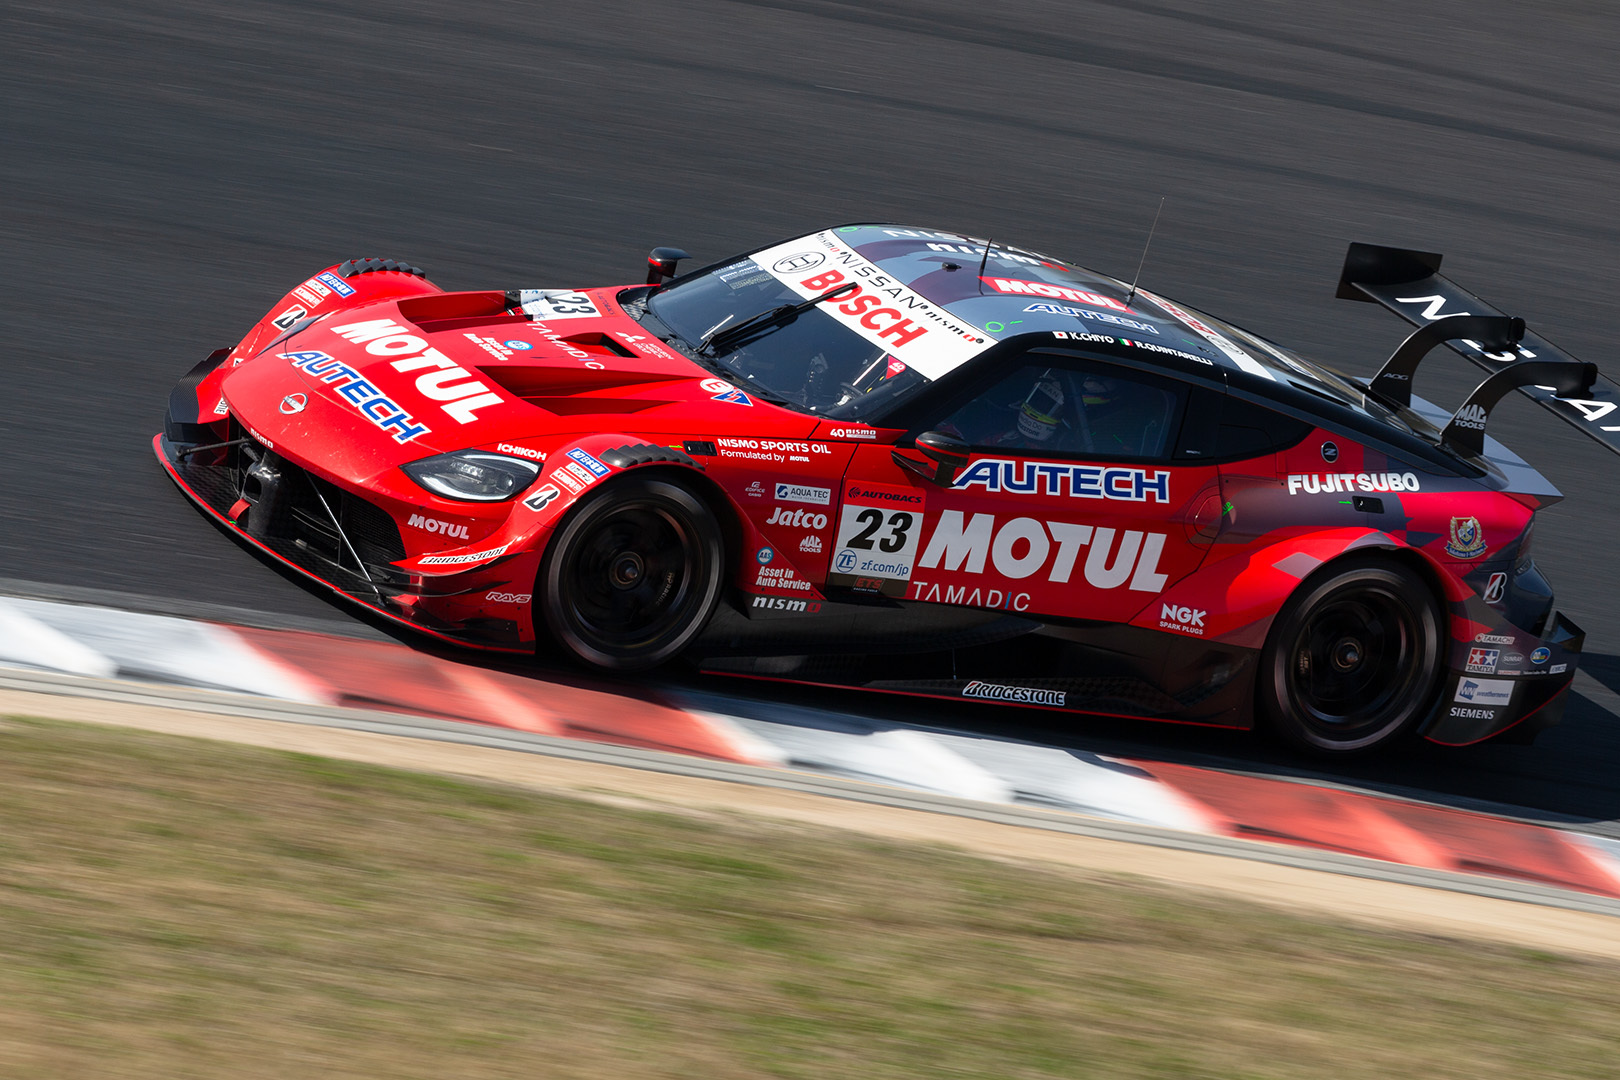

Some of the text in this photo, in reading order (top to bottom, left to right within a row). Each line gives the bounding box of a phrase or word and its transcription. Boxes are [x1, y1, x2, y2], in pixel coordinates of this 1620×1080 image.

[926, 243, 1070, 272] nismo
[837, 253, 922, 310] NISSAN
[994, 279, 1127, 312] MOTUL
[925, 311, 977, 341] nismo
[1022, 303, 1160, 334] AUTECH
[1070, 332, 1115, 344] K.CHIYO
[1135, 340, 1213, 366] R.QUINTARELLI
[330, 319, 505, 424] MOTUL
[275, 350, 432, 445] AUTECH
[1456, 404, 1487, 423] MAC
[830, 429, 845, 437] 40
[1455, 420, 1485, 430] TOOLS
[250, 427, 274, 448] nismo
[717, 438, 831, 454] NISMO SPORTS OIL
[497, 443, 547, 460] ICHIKOH
[720, 450, 772, 461] Formulated
[774, 453, 785, 462] by
[952, 458, 1171, 504] AUTECH
[1287, 472, 1420, 495] FUJITSUBO
[790, 489, 829, 498] AQUA TEC
[861, 490, 922, 503] AUTOBACS
[407, 513, 470, 540] MOTUL
[766, 507, 827, 530] Jatco
[846, 508, 913, 553] 23
[799, 535, 822, 548] MAC
[420, 546, 507, 564] BRIDGESTONE
[759, 551, 773, 560] AAS
[917, 509, 1169, 593] MOTUL
[758, 566, 794, 579] Asset in
[838, 554, 909, 576] ZF zf.com/jp
[756, 575, 811, 591] Auto Service
[855, 577, 882, 588] ETS
[485, 591, 532, 603] RAYS
[752, 597, 822, 613] nismo
[912, 581, 1031, 611] TAMADIC
[1160, 602, 1208, 628] NGK
[1159, 621, 1204, 635] SPARK PLUGS
[1484, 635, 1514, 644] TAMACHI
[1467, 665, 1494, 673] TAMIYA
[962, 680, 1067, 706] BRIDGESTONE
[1450, 707, 1495, 720] SIEMENS
